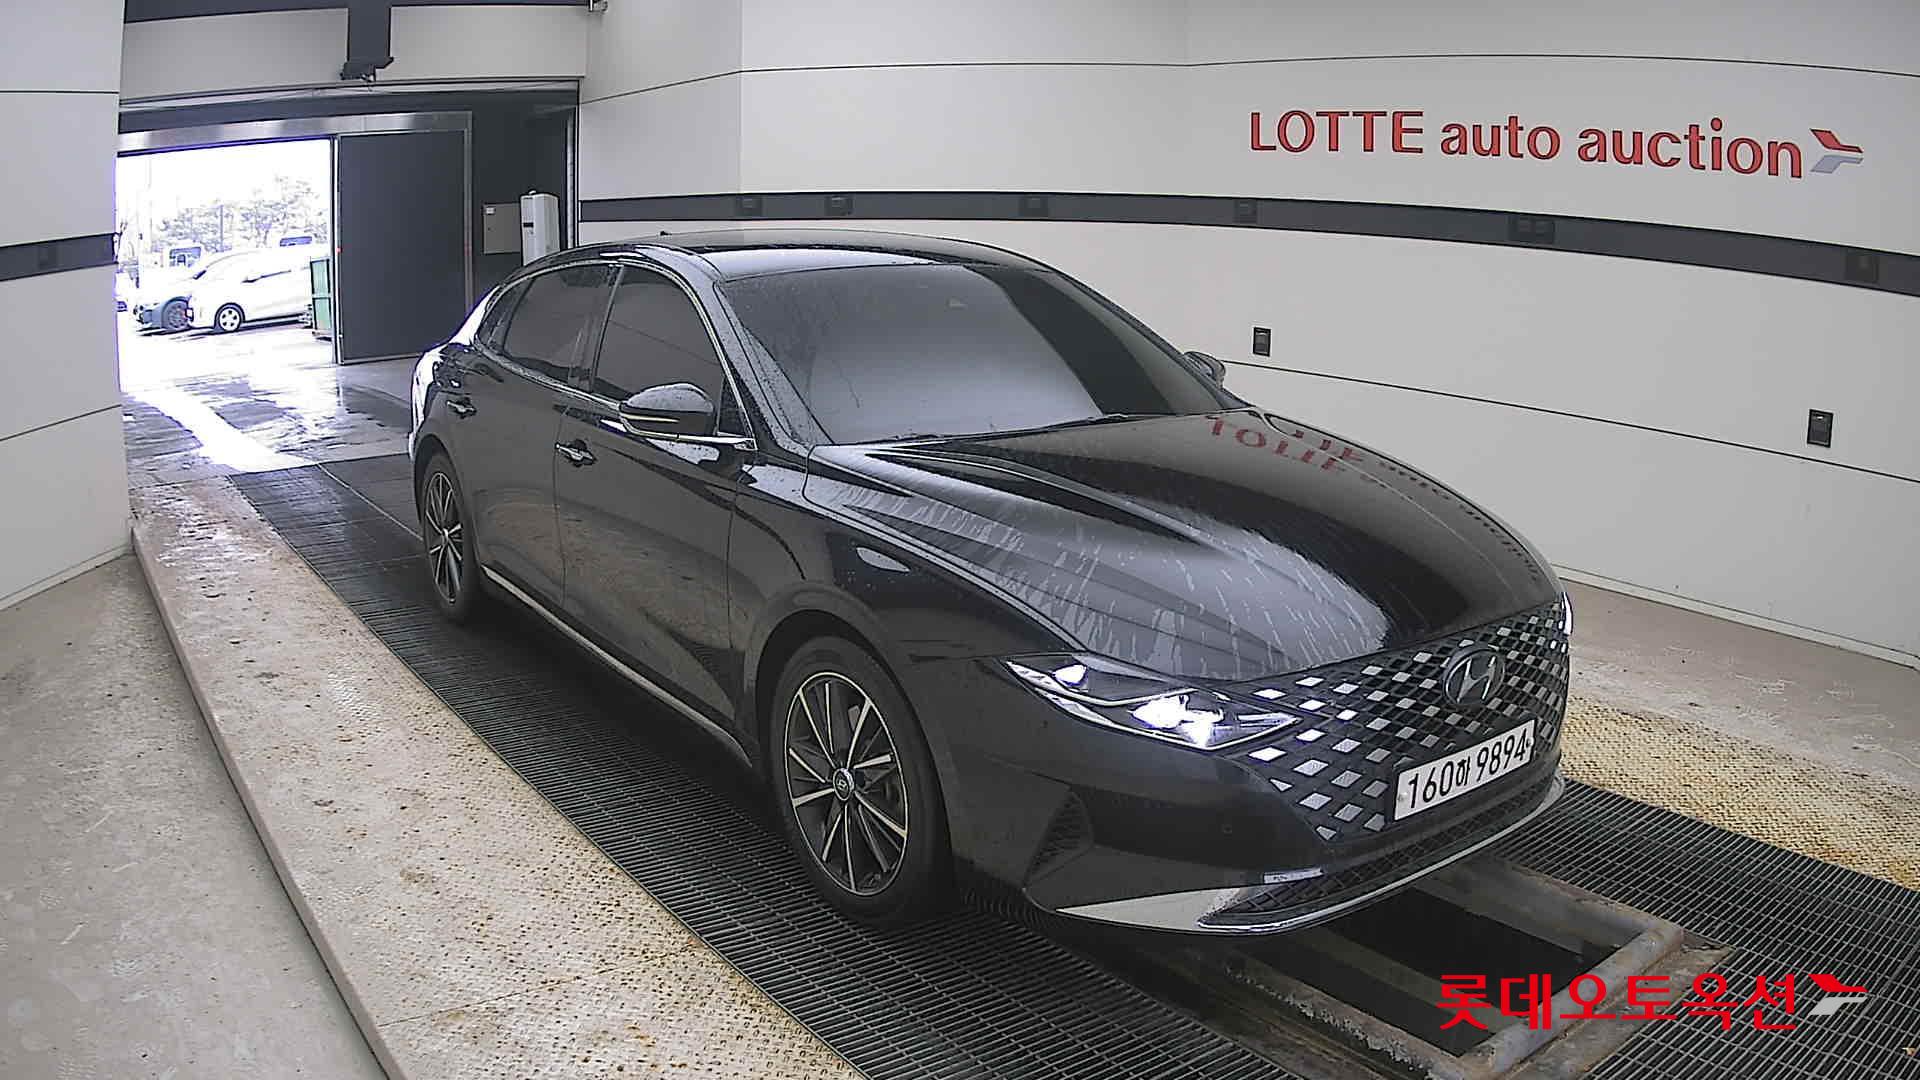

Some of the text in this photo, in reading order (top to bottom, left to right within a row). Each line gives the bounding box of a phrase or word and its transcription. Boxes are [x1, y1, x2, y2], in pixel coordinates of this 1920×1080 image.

[1250, 111, 1802, 178] LOTTE auto auction
